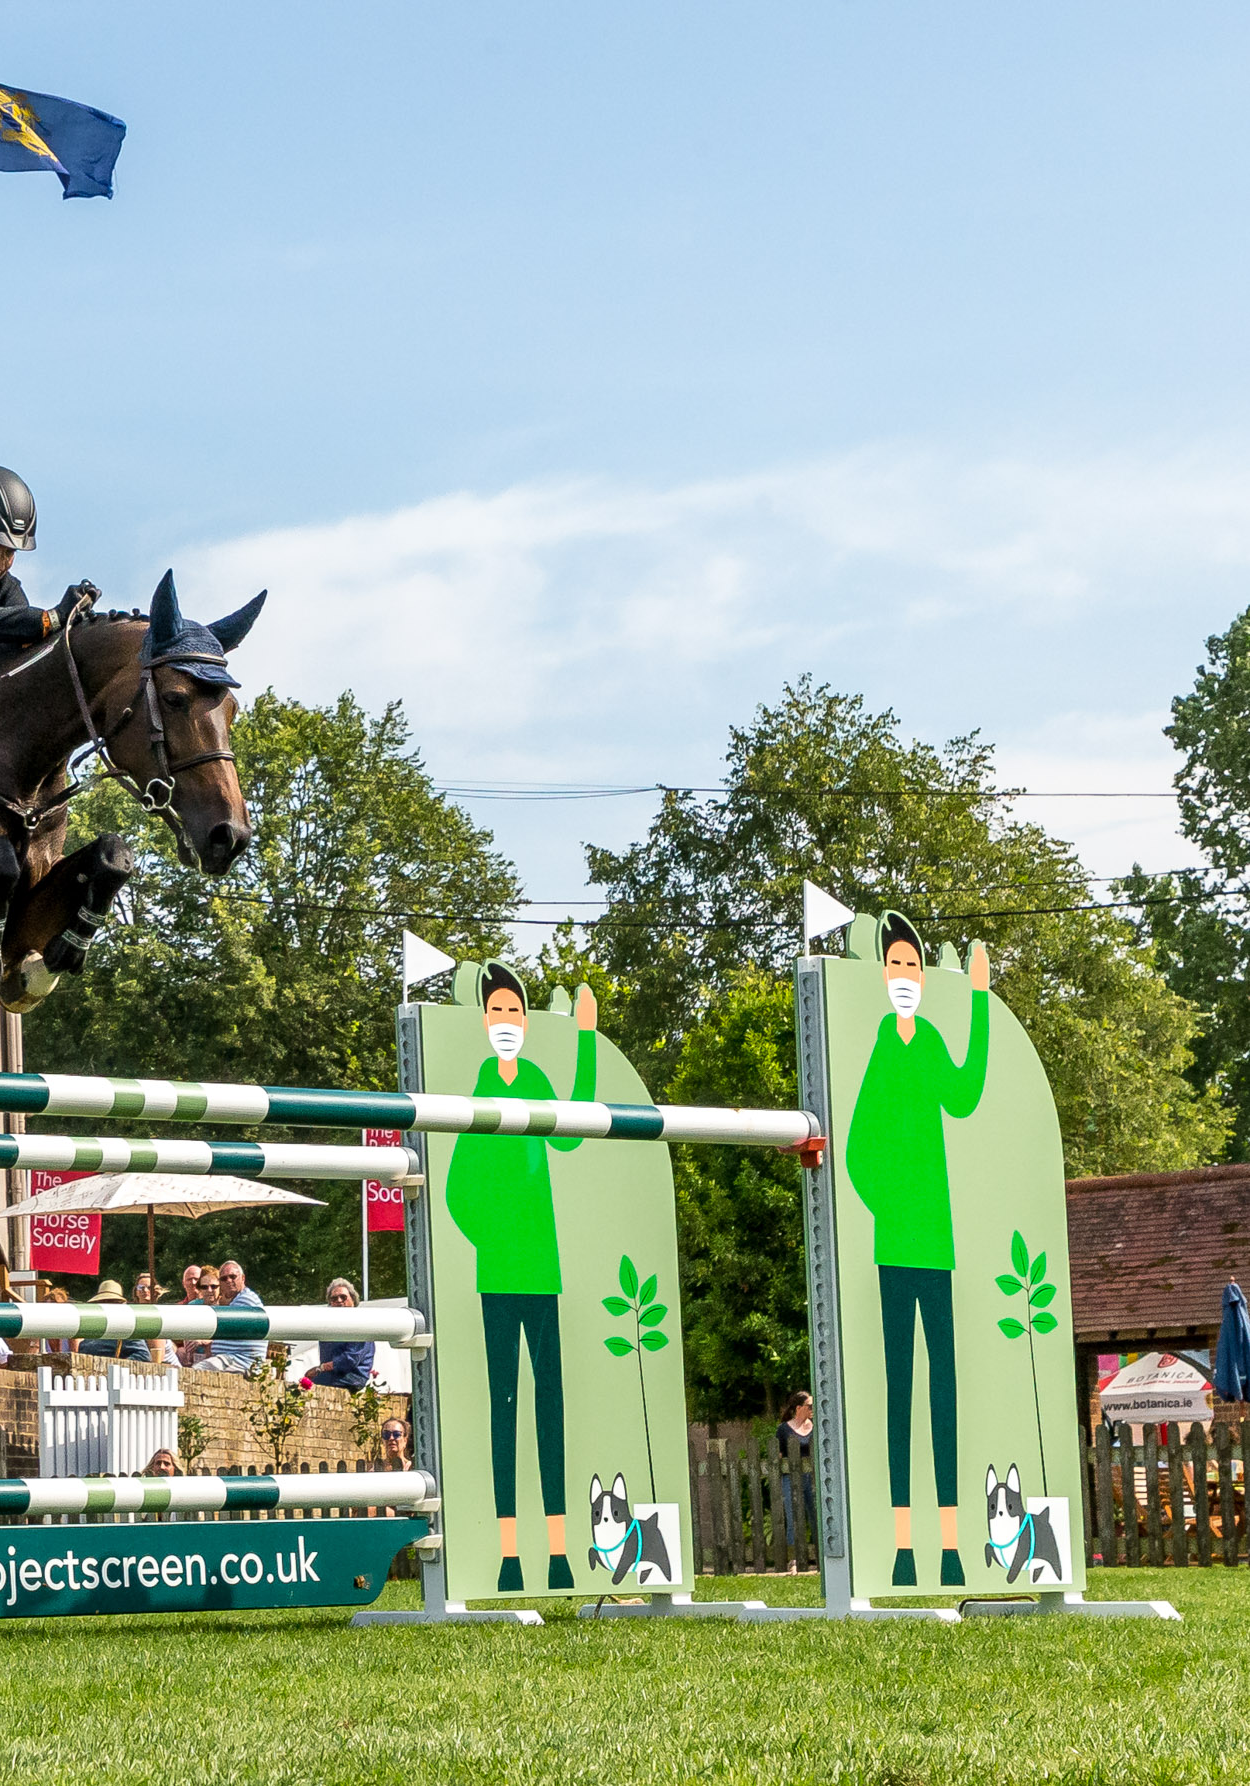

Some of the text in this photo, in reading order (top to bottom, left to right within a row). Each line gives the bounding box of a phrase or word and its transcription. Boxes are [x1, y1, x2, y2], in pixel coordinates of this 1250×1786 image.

[35, 1171, 62, 1187] The
[33, 1214, 90, 1230] Horse
[32, 1227, 97, 1255] Society
[1126, 1371, 1195, 1384] BOTANICA
[1104, 1398, 1193, 1411] www.botanica.ie
